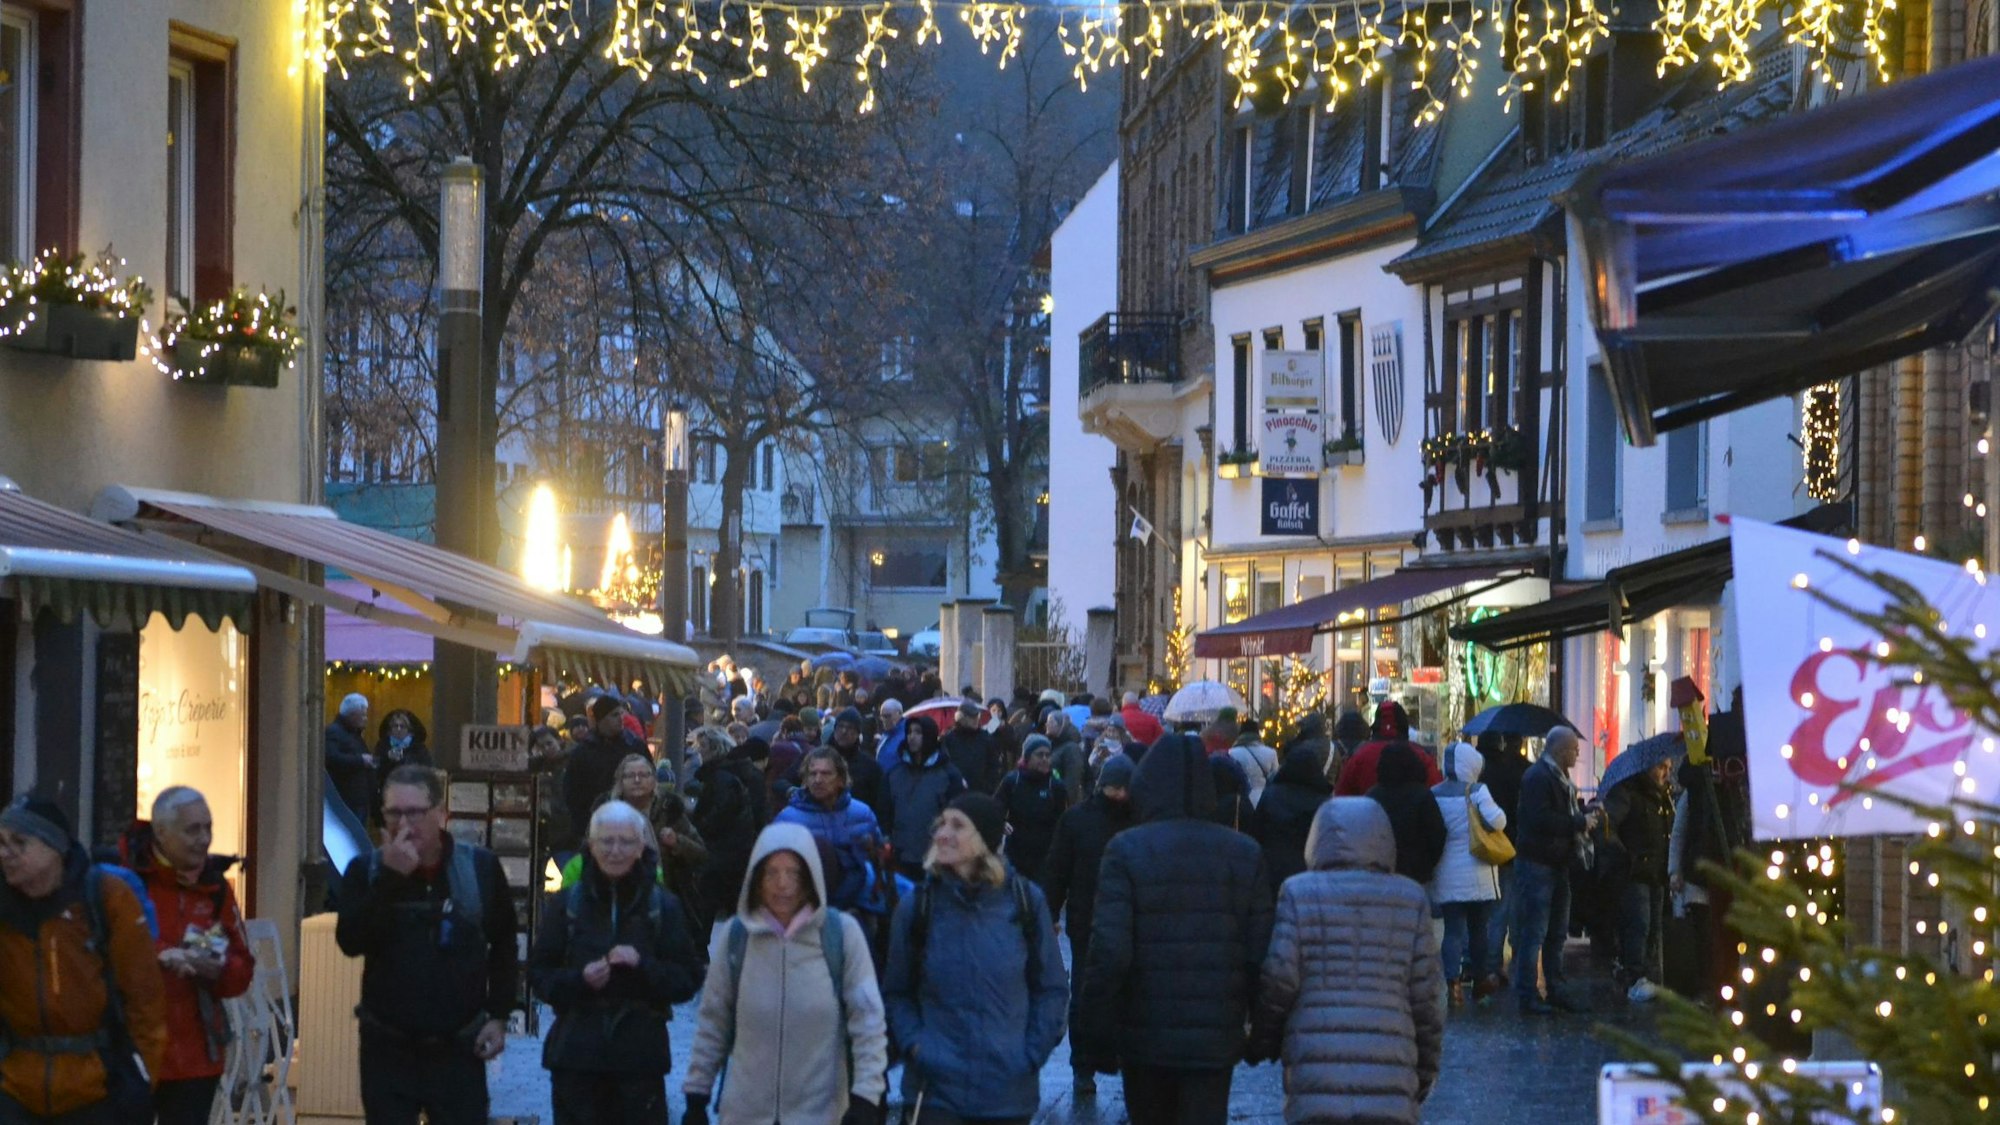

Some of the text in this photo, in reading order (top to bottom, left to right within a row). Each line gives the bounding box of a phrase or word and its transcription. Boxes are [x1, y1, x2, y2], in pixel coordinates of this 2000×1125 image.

[1270, 371, 1313, 388] Bitburger
[1265, 415, 1318, 433] Pinocchio
[1269, 455, 1311, 463] PIZZERIA
[1266, 464, 1315, 473] Ristorante
[1270, 501, 1311, 520] Gaffel
[178, 688, 226, 738] Crêperie
[469, 731, 521, 750] KULT
